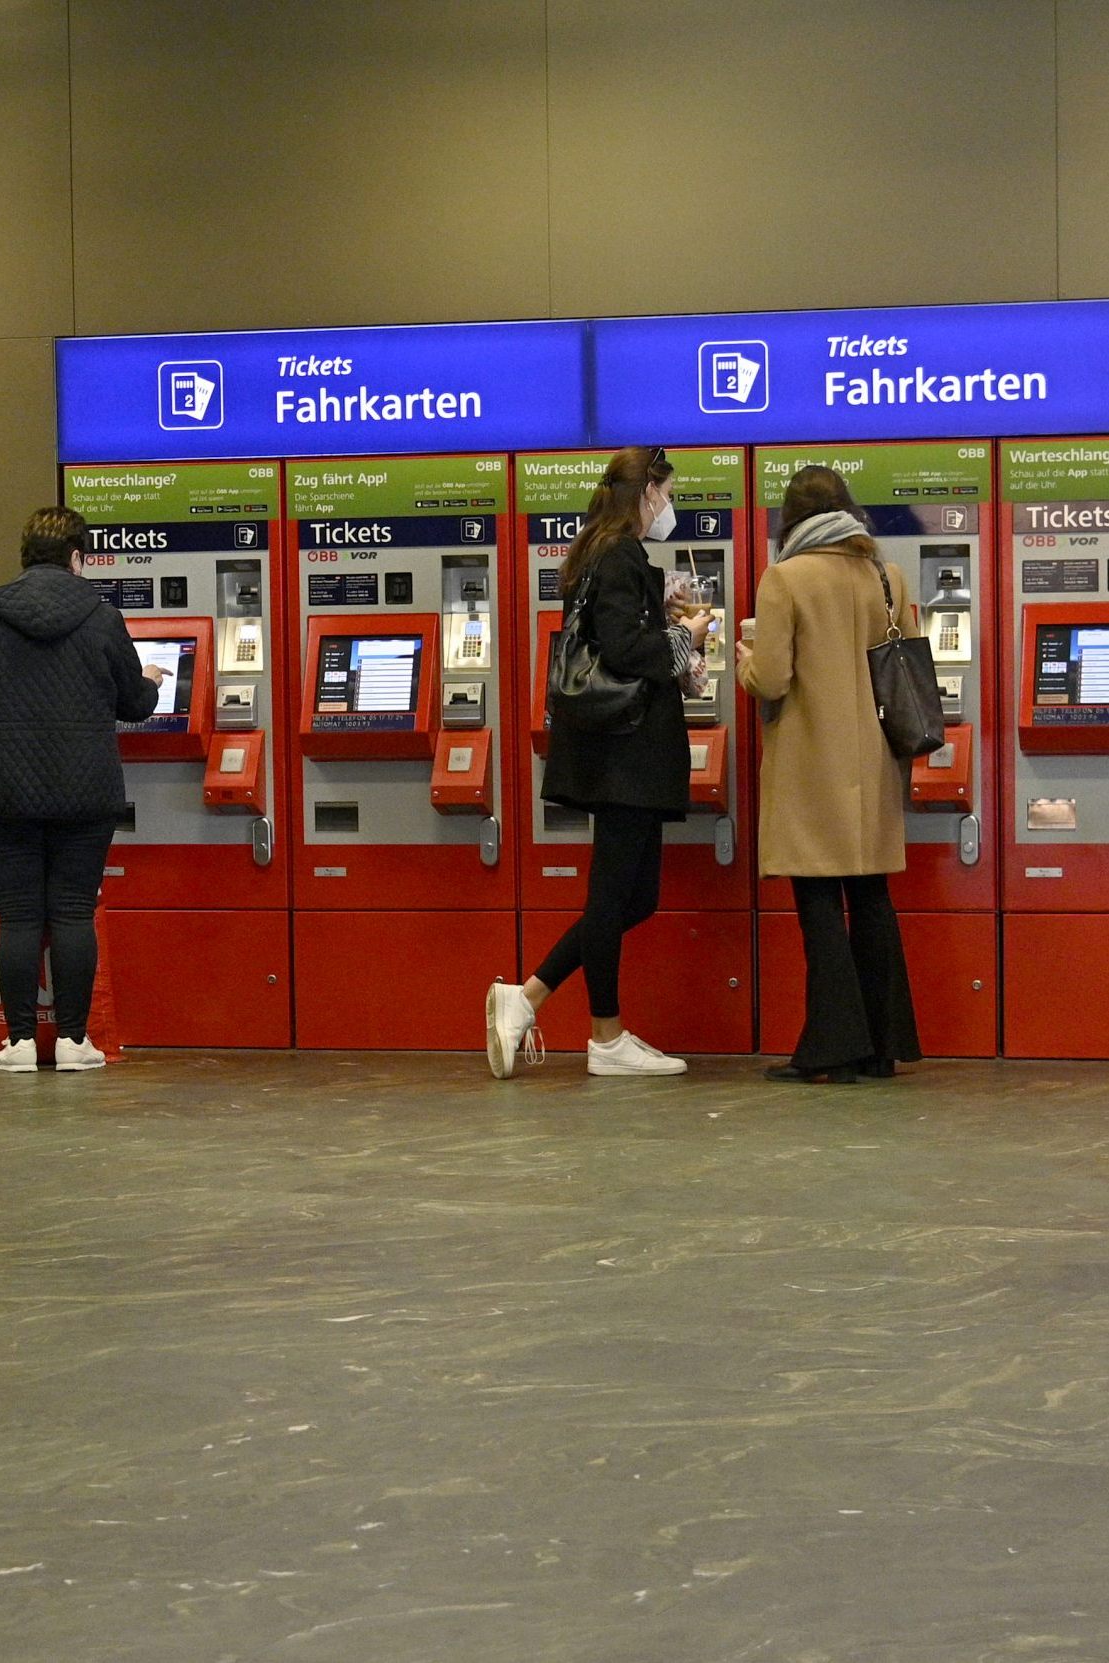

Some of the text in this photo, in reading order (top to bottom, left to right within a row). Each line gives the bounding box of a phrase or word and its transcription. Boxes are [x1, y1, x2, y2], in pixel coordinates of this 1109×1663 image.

[827, 336, 907, 357] Tickets
[278, 356, 352, 377] Tickets
[825, 367, 1047, 405] Fahrkarten
[276, 387, 481, 423] Fahrkarten
[958, 448, 985, 458] ÖBB
[712, 455, 738, 465] ÖBB
[476, 462, 501, 471] ÖBB
[764, 460, 789, 476] Zug
[832, 459, 863, 474] App!
[249, 468, 273, 478] ÖBB
[1010, 468, 1108, 479] Schau auf die App statt
[72, 473, 176, 489] Warteschlange?
[294, 473, 387, 488] Zug fährt App!
[524, 481, 597, 491] Schau auf die App
[764, 479, 778, 489] Die
[1010, 481, 1023, 490] auf
[1025, 481, 1038, 489] die
[72, 492, 161, 503] Schau auf die App statt
[295, 491, 355, 502] Die Sparschiene
[524, 493, 538, 501] auf
[539, 492, 553, 501] die
[764, 490, 783, 500] fährt
[87, 504, 99, 512] die
[295, 503, 313, 512] fährt
[1026, 505, 1109, 528] Tickets
[310, 522, 392, 544] Tickets
[541, 516, 584, 540] Tick
[89, 528, 168, 550] Tickets
[1023, 536, 1099, 547] ÖBB VOR
[86, 555, 152, 565] ÖBB VOR
[308, 551, 377, 562] ÖBB VOR
